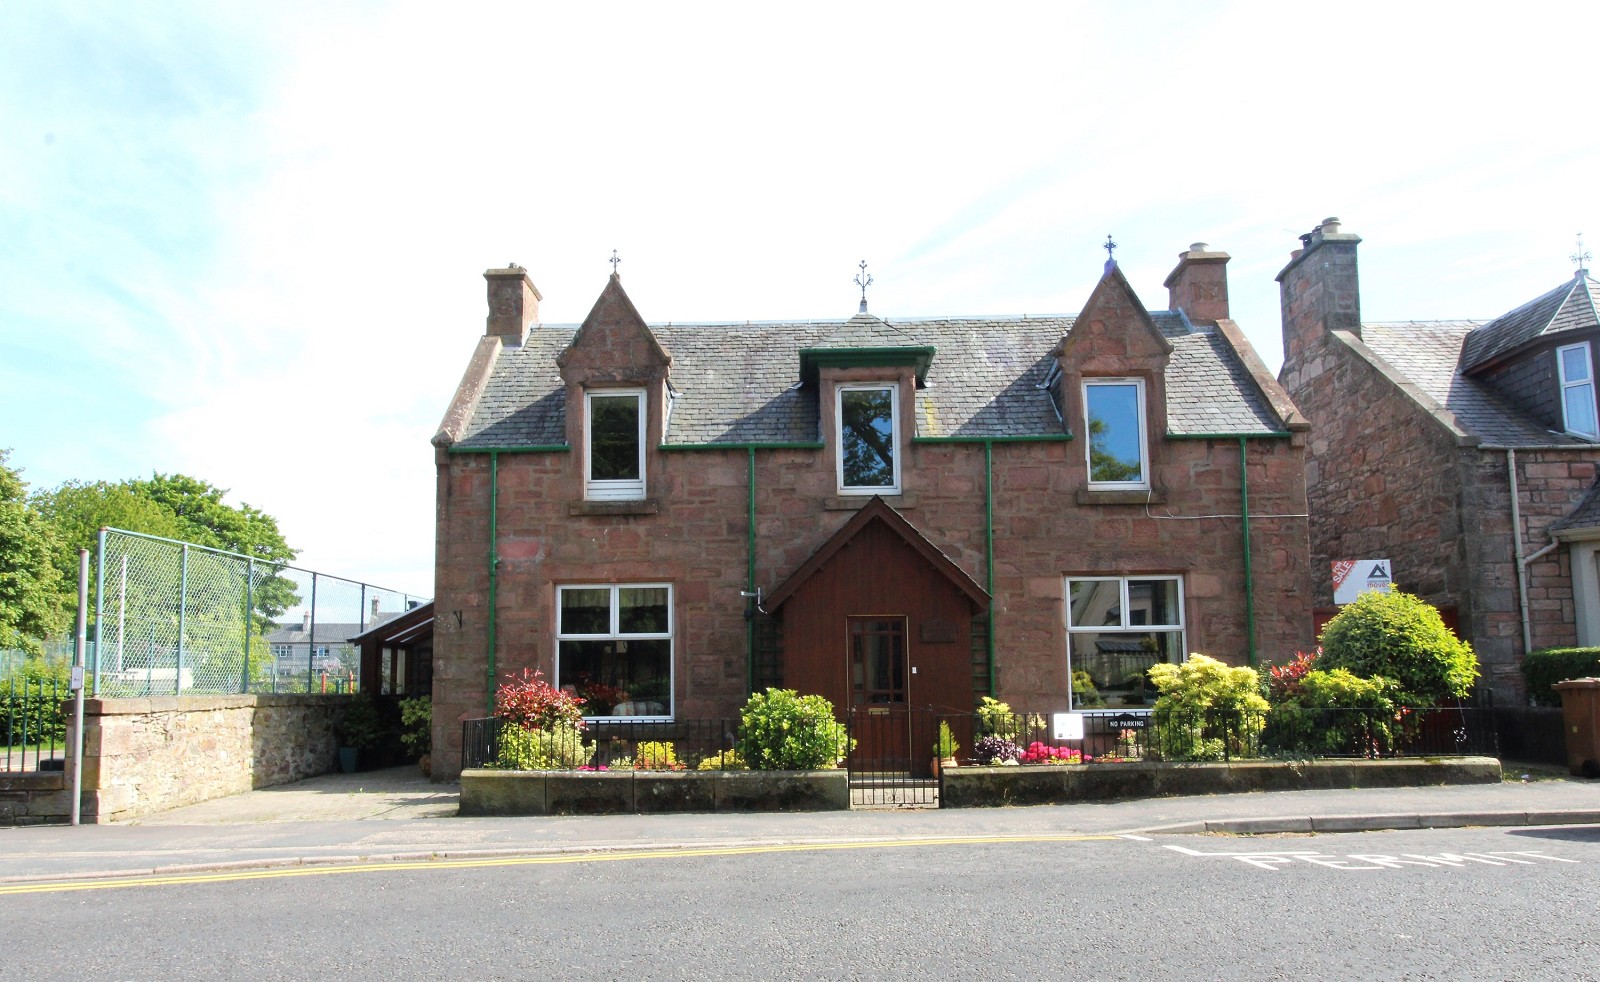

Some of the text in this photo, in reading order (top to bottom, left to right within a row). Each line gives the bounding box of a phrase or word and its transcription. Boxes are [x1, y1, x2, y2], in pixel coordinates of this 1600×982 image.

[1332, 561, 1343, 573] FOR
[1333, 561, 1352, 583] SALE
[1232, 851, 1581, 871] PERMIT
